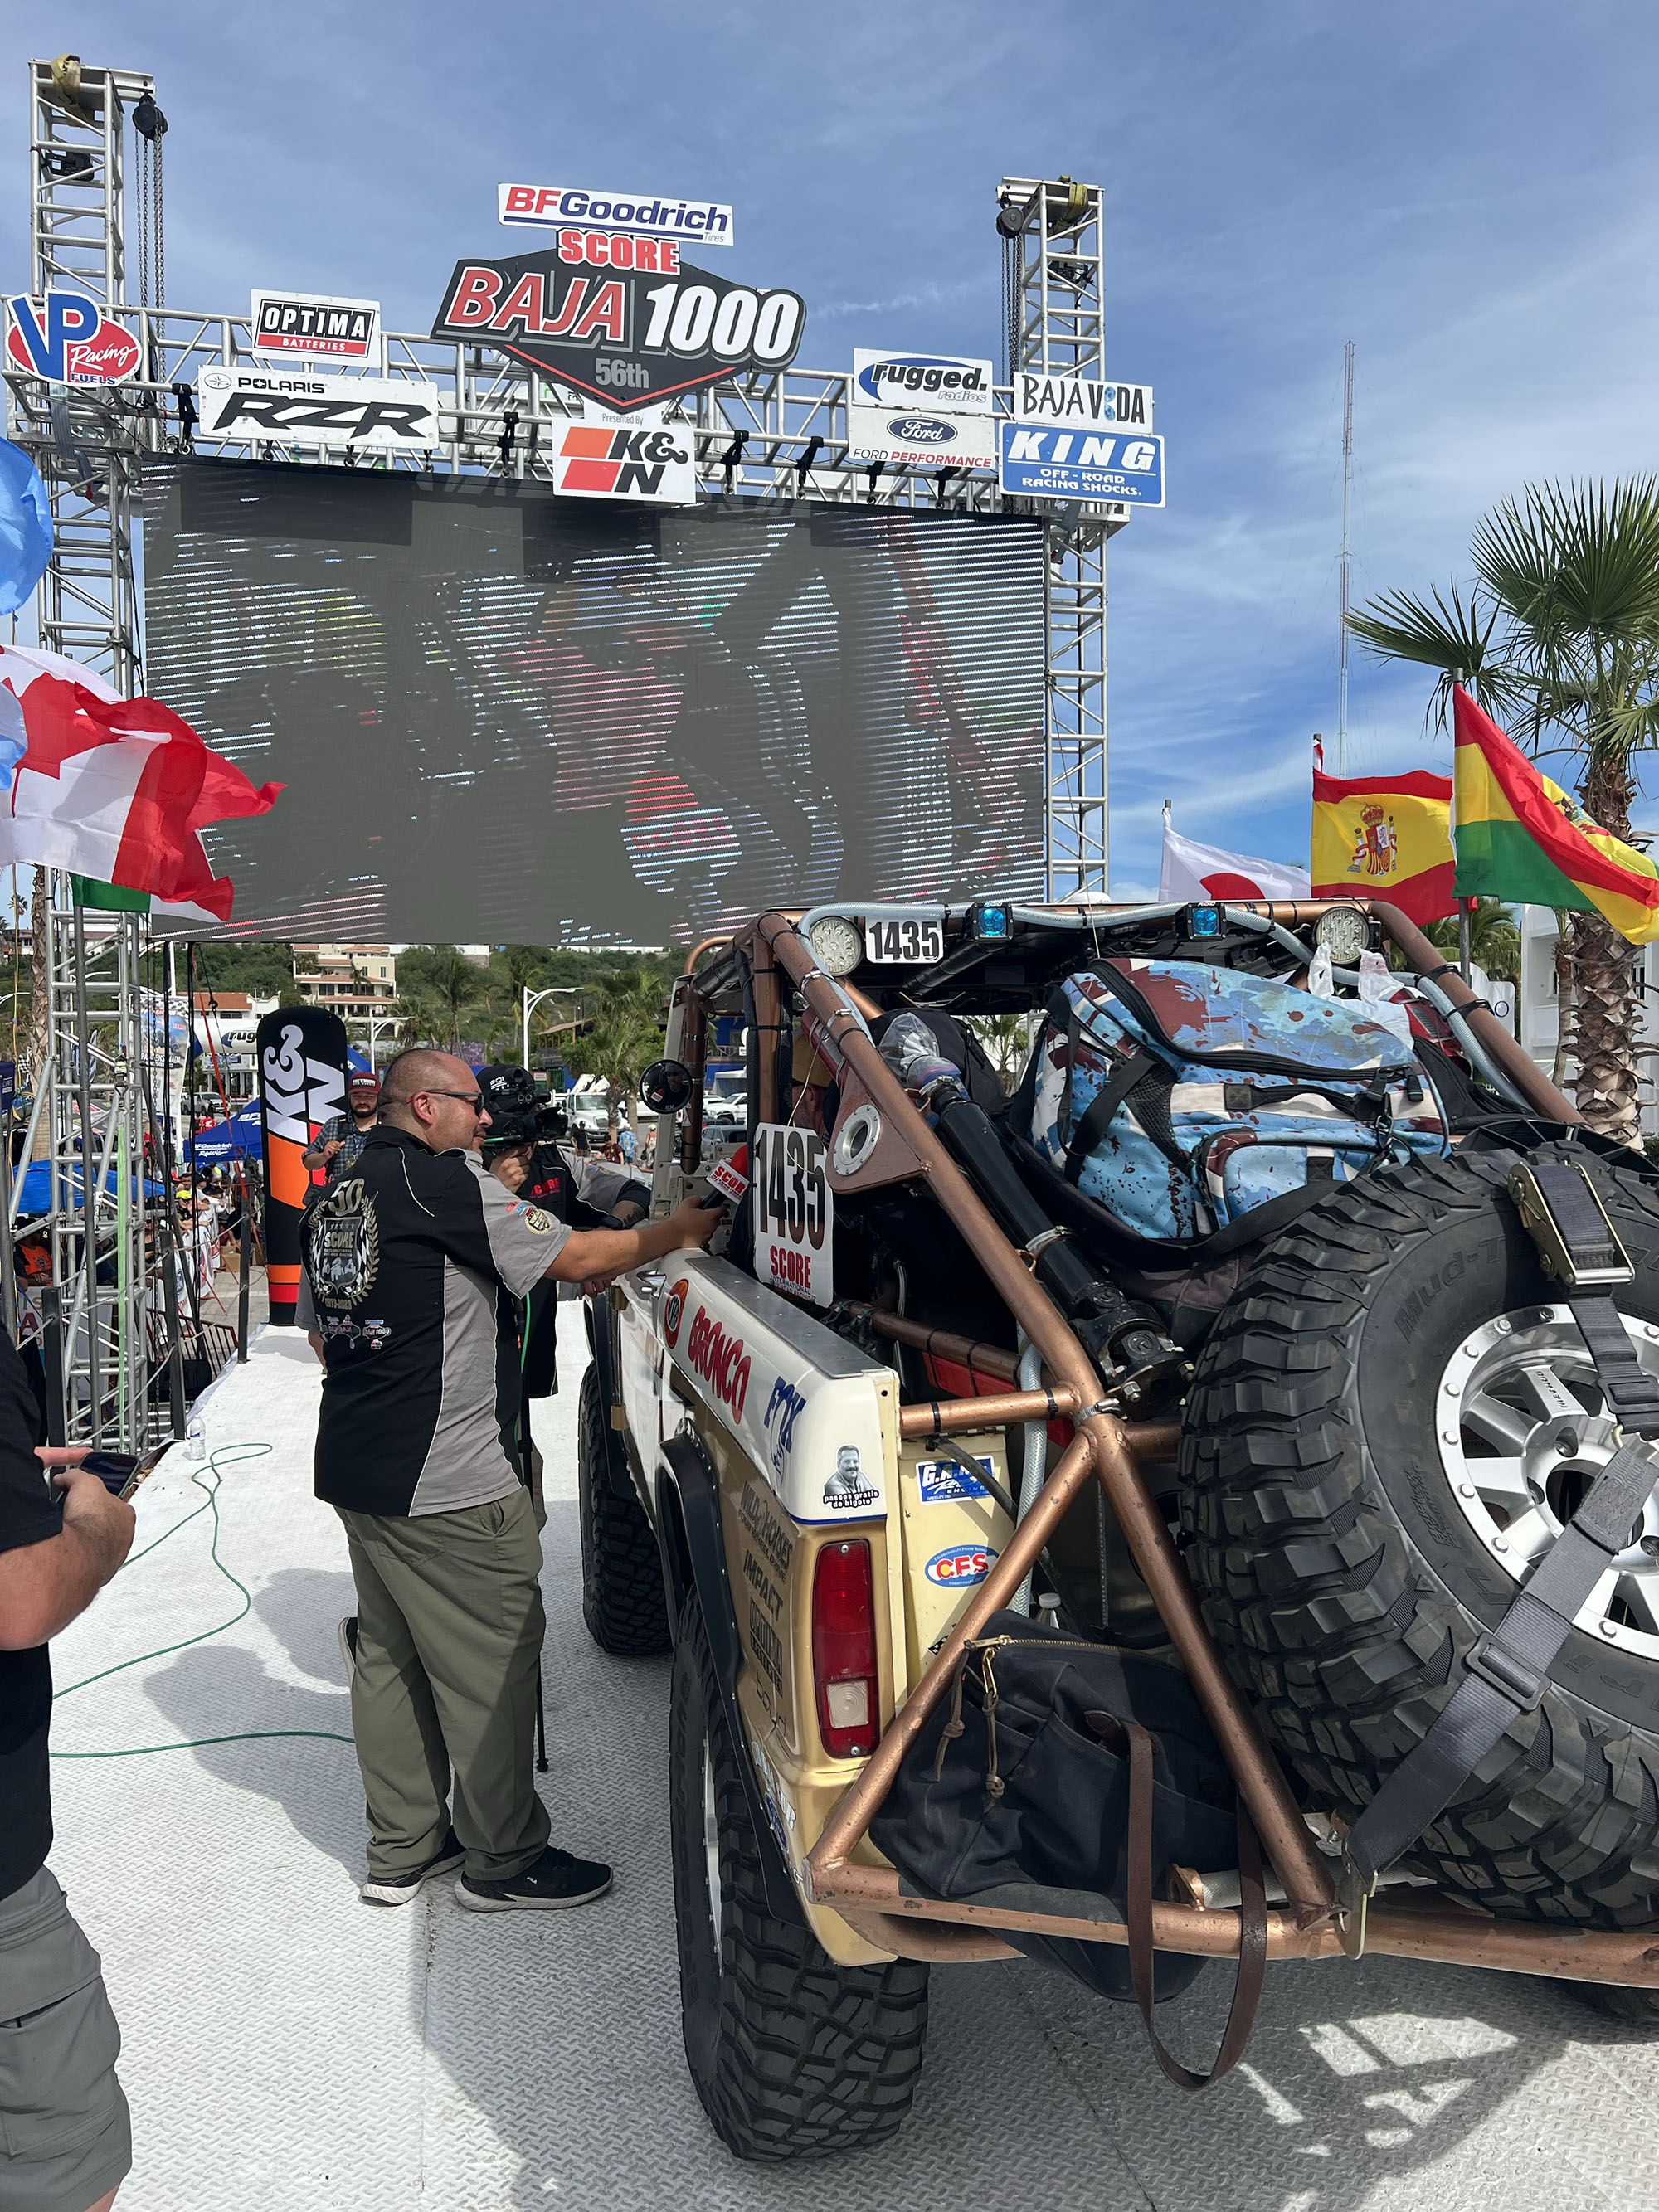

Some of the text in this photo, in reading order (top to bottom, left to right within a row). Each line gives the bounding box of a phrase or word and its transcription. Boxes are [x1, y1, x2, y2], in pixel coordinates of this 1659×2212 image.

[504, 186, 729, 232] BFGoodrich
[559, 229, 679, 275] SCORE
[704, 232, 724, 243] Tires
[262, 303, 366, 339] OPTIMA
[445, 267, 800, 359] BAJA 1000
[10, 290, 100, 382] VP
[282, 336, 346, 352] BATTERIES
[70, 343, 138, 372] Racing
[71, 373, 116, 385] FUELS
[238, 377, 325, 394] POLARIS
[595, 358, 649, 389] 56th
[938, 389, 986, 404] radios
[1022, 374, 1084, 417] BAJA
[212, 392, 433, 439] RZR
[602, 413, 644, 425] Presented By
[900, 419, 944, 442] Ford
[853, 449, 992, 469] FORD PERFORMANCE
[1008, 430, 1155, 471] KING
[1022, 478, 1078, 491] RACING
[868, 921, 940, 960] 1435
[714, 1165, 747, 1194] SCOR
[756, 1130, 825, 1250] 1435
[324, 1232, 354, 1247] SCORE
[770, 1245, 811, 1289] SCORE
[688, 1305, 752, 1425] BRONCO
[764, 1376, 806, 1454] FOX
[825, 1491, 878, 1503] paseos gratis
[833, 1498, 870, 1508] de bigote
[936, 1553, 989, 1578] CFS
[743, 1549, 783, 1621] IMPACT
